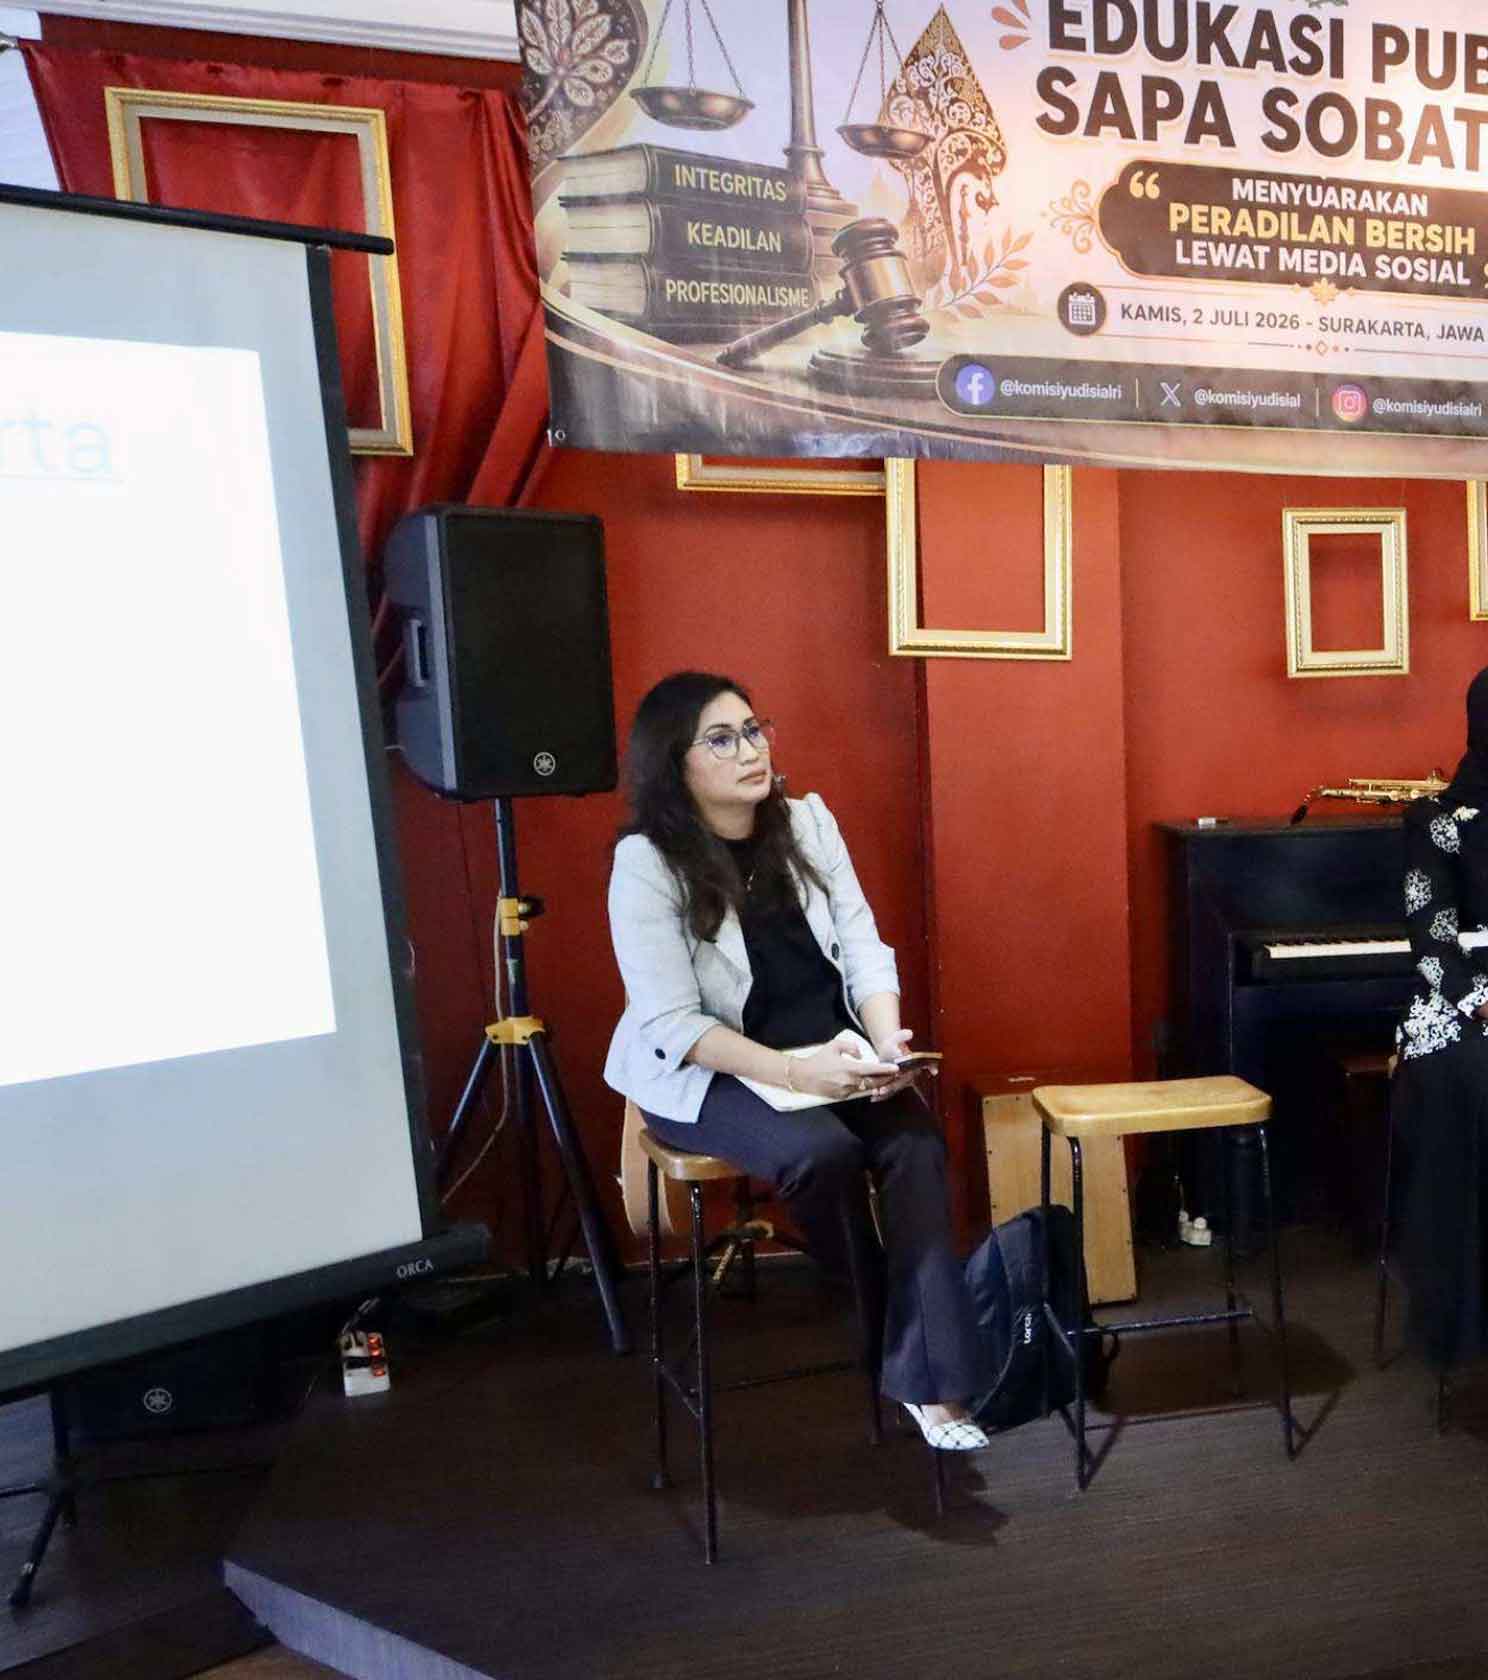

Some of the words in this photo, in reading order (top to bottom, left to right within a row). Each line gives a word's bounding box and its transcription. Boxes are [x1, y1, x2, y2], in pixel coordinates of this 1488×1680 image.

[1049, 0, 1344, 79] EDUKASI
[1035, 66, 1237, 148] SAPA
[674, 164, 787, 201] INTEGRITAS
[1232, 178, 1428, 217] MENYUARAKAN
[688, 221, 782, 252] KEADILAN
[1169, 203, 1355, 245] PERADILAN
[1366, 219, 1475, 255] BERSIH
[1175, 239, 1270, 269] LEWAT
[1279, 250, 1367, 277] MEDIA
[1375, 260, 1471, 286] SOSIAL
[666, 279, 810, 307] PROFESIONALISME
[1121, 304, 1187, 326] KAMIS,
[1193, 308, 1203, 324] 2
[1209, 309, 1249, 326] JULI
[1255, 311, 1300, 329] 2026
[1319, 316, 1431, 342] SURAKARTA,
[1436, 324, 1485, 343] JAWA
[1000, 379, 1122, 400] @komisiyudisialri
[1194, 389, 1301, 409] @komisiyudisial
[1372, 398, 1482, 418] @komisiyudisialri
[396, 1259, 434, 1279] ORCA
